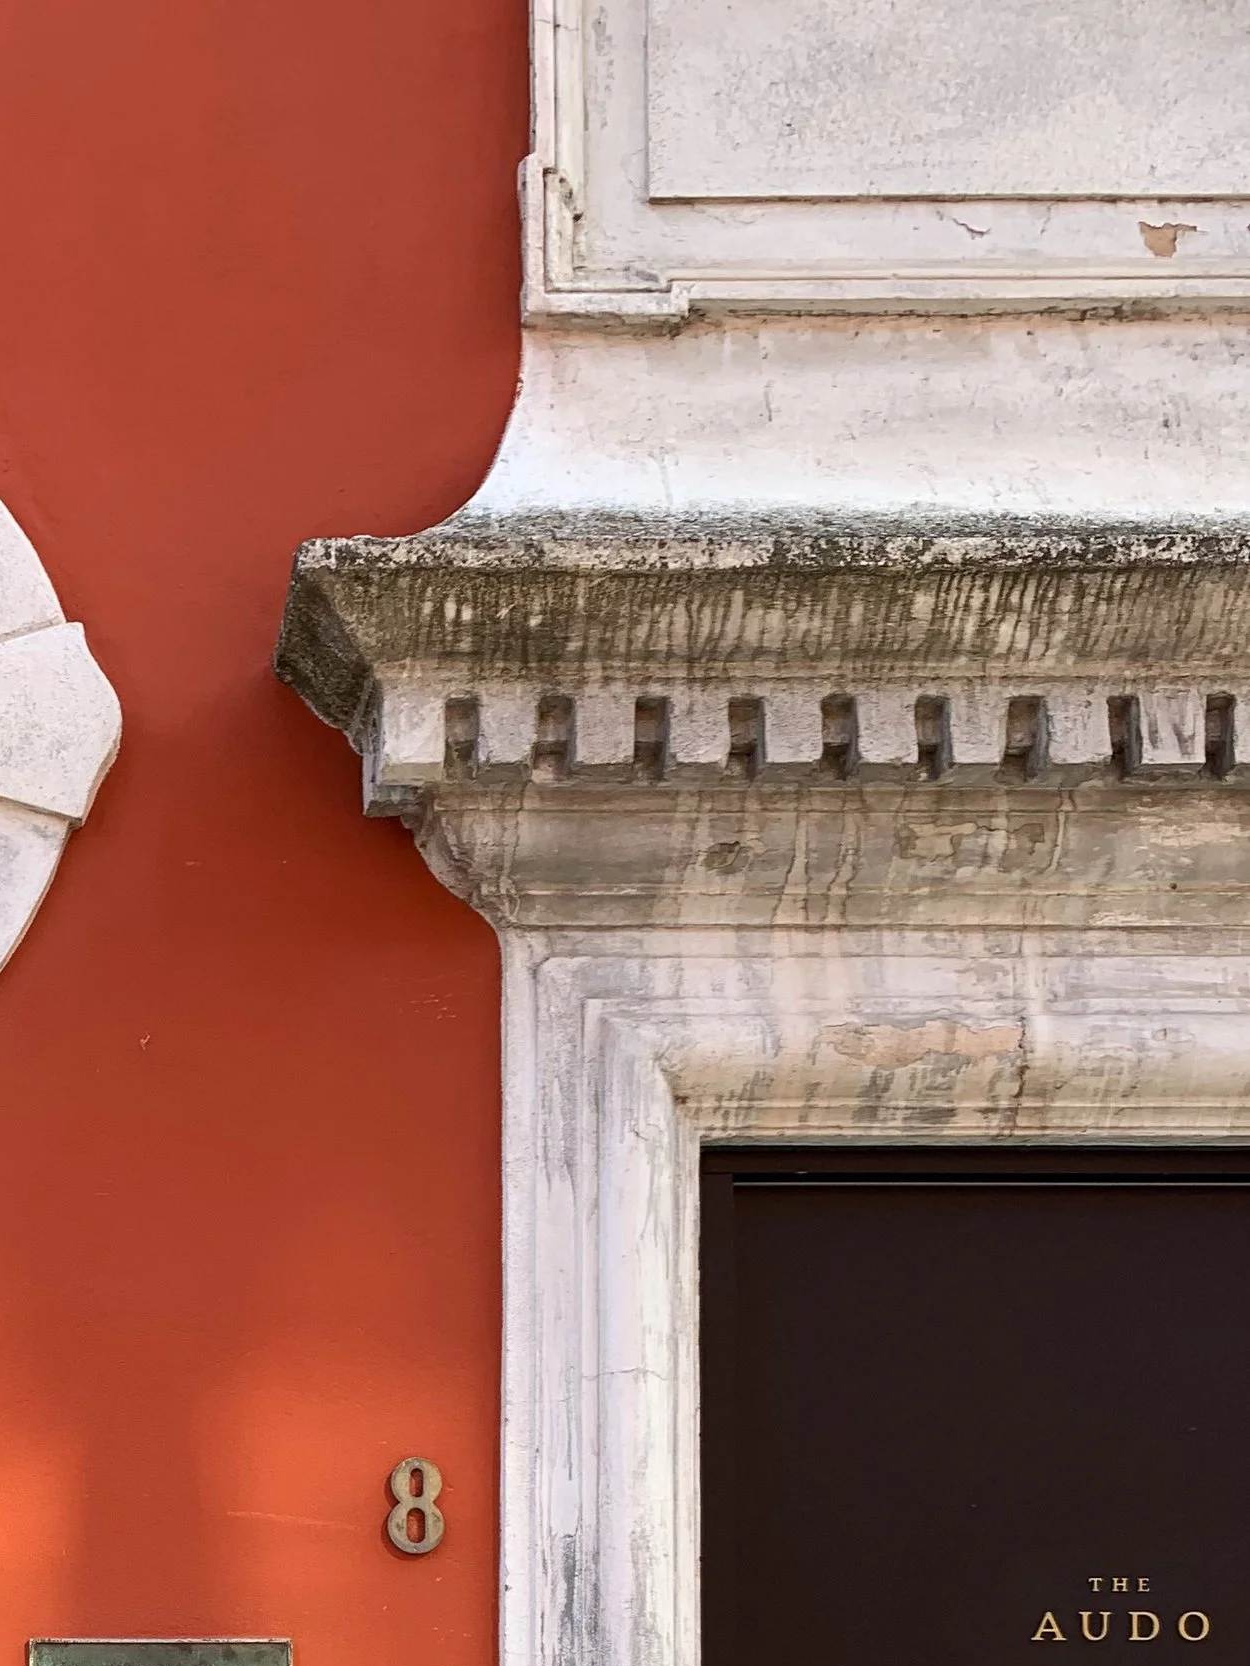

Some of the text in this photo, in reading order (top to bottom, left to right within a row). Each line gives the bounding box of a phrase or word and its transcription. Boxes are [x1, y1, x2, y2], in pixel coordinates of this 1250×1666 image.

[387, 1456, 445, 1554] 8
[1088, 1577, 1150, 1592] THE
[1030, 1611, 1210, 1641] AUDO
